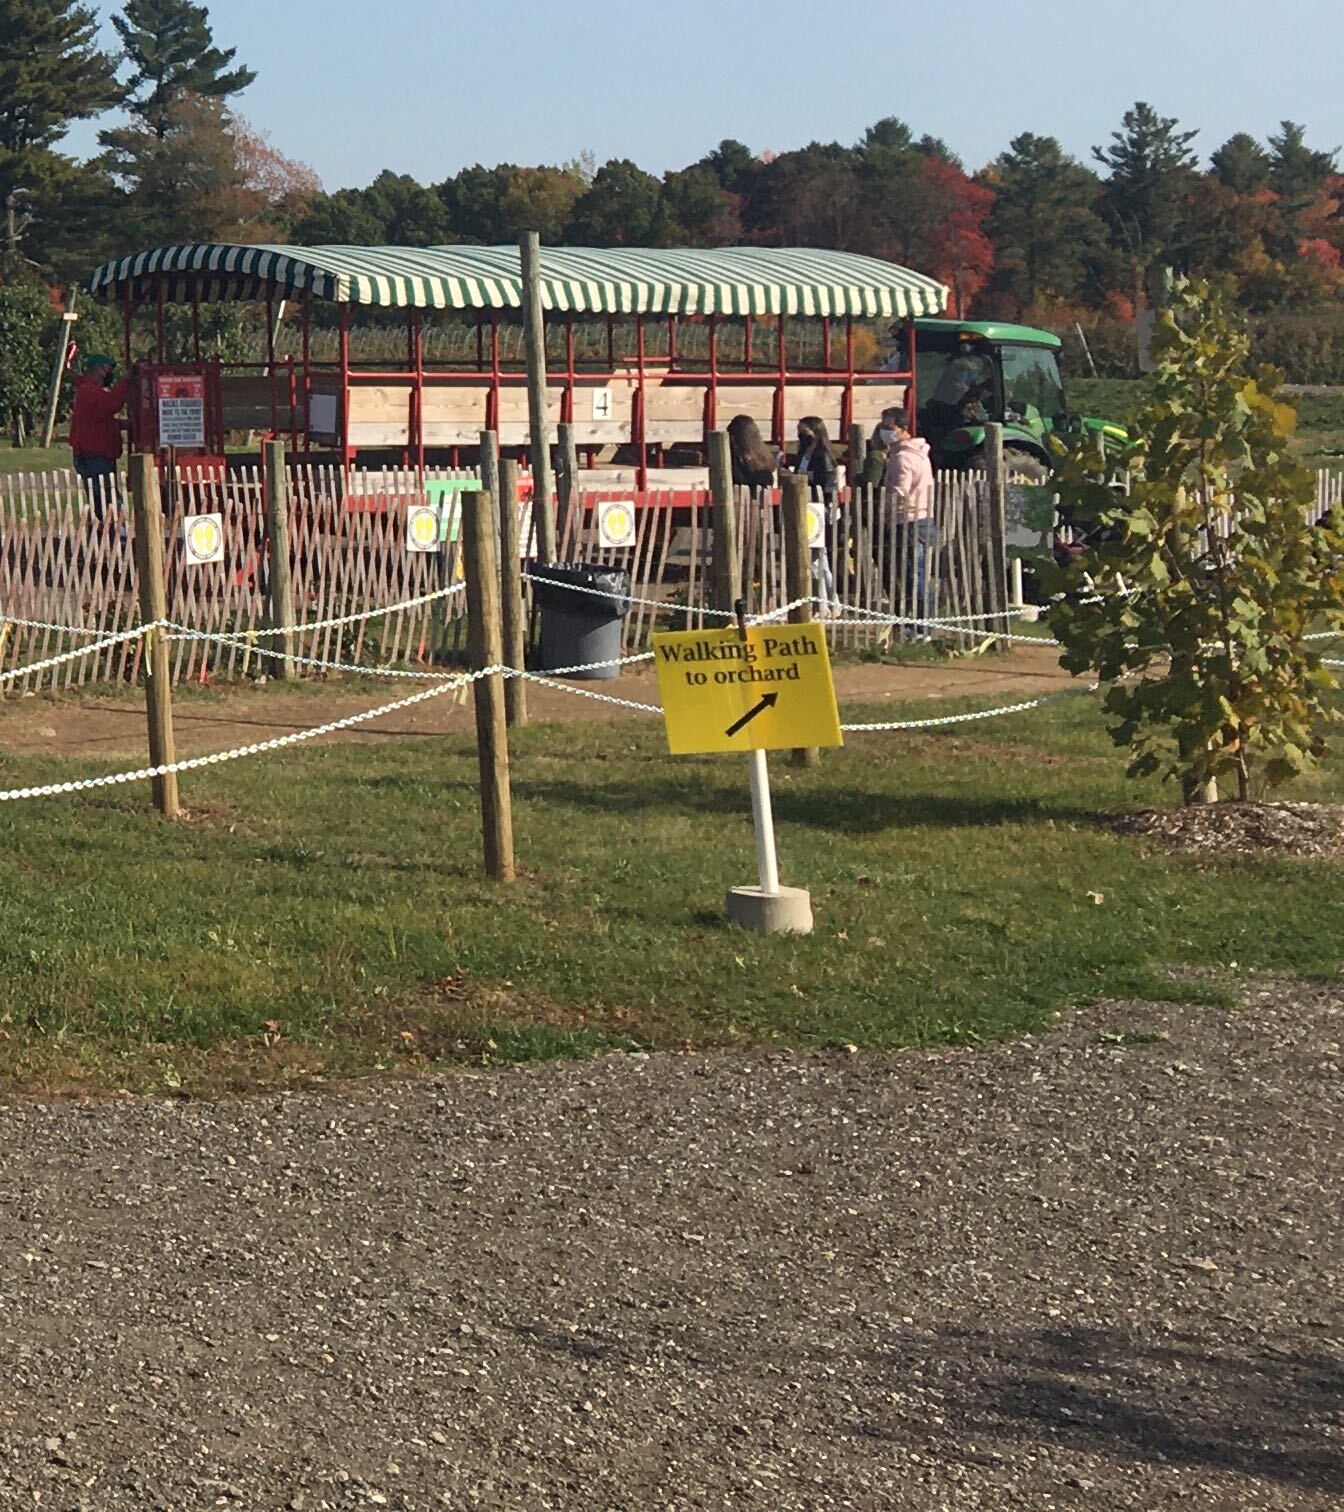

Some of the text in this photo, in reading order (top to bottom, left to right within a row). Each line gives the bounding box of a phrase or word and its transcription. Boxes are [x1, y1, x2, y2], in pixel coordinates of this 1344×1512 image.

[595, 392, 609, 417] 4
[659, 635, 819, 662] Walking Path
[685, 663, 801, 685] to orchard
